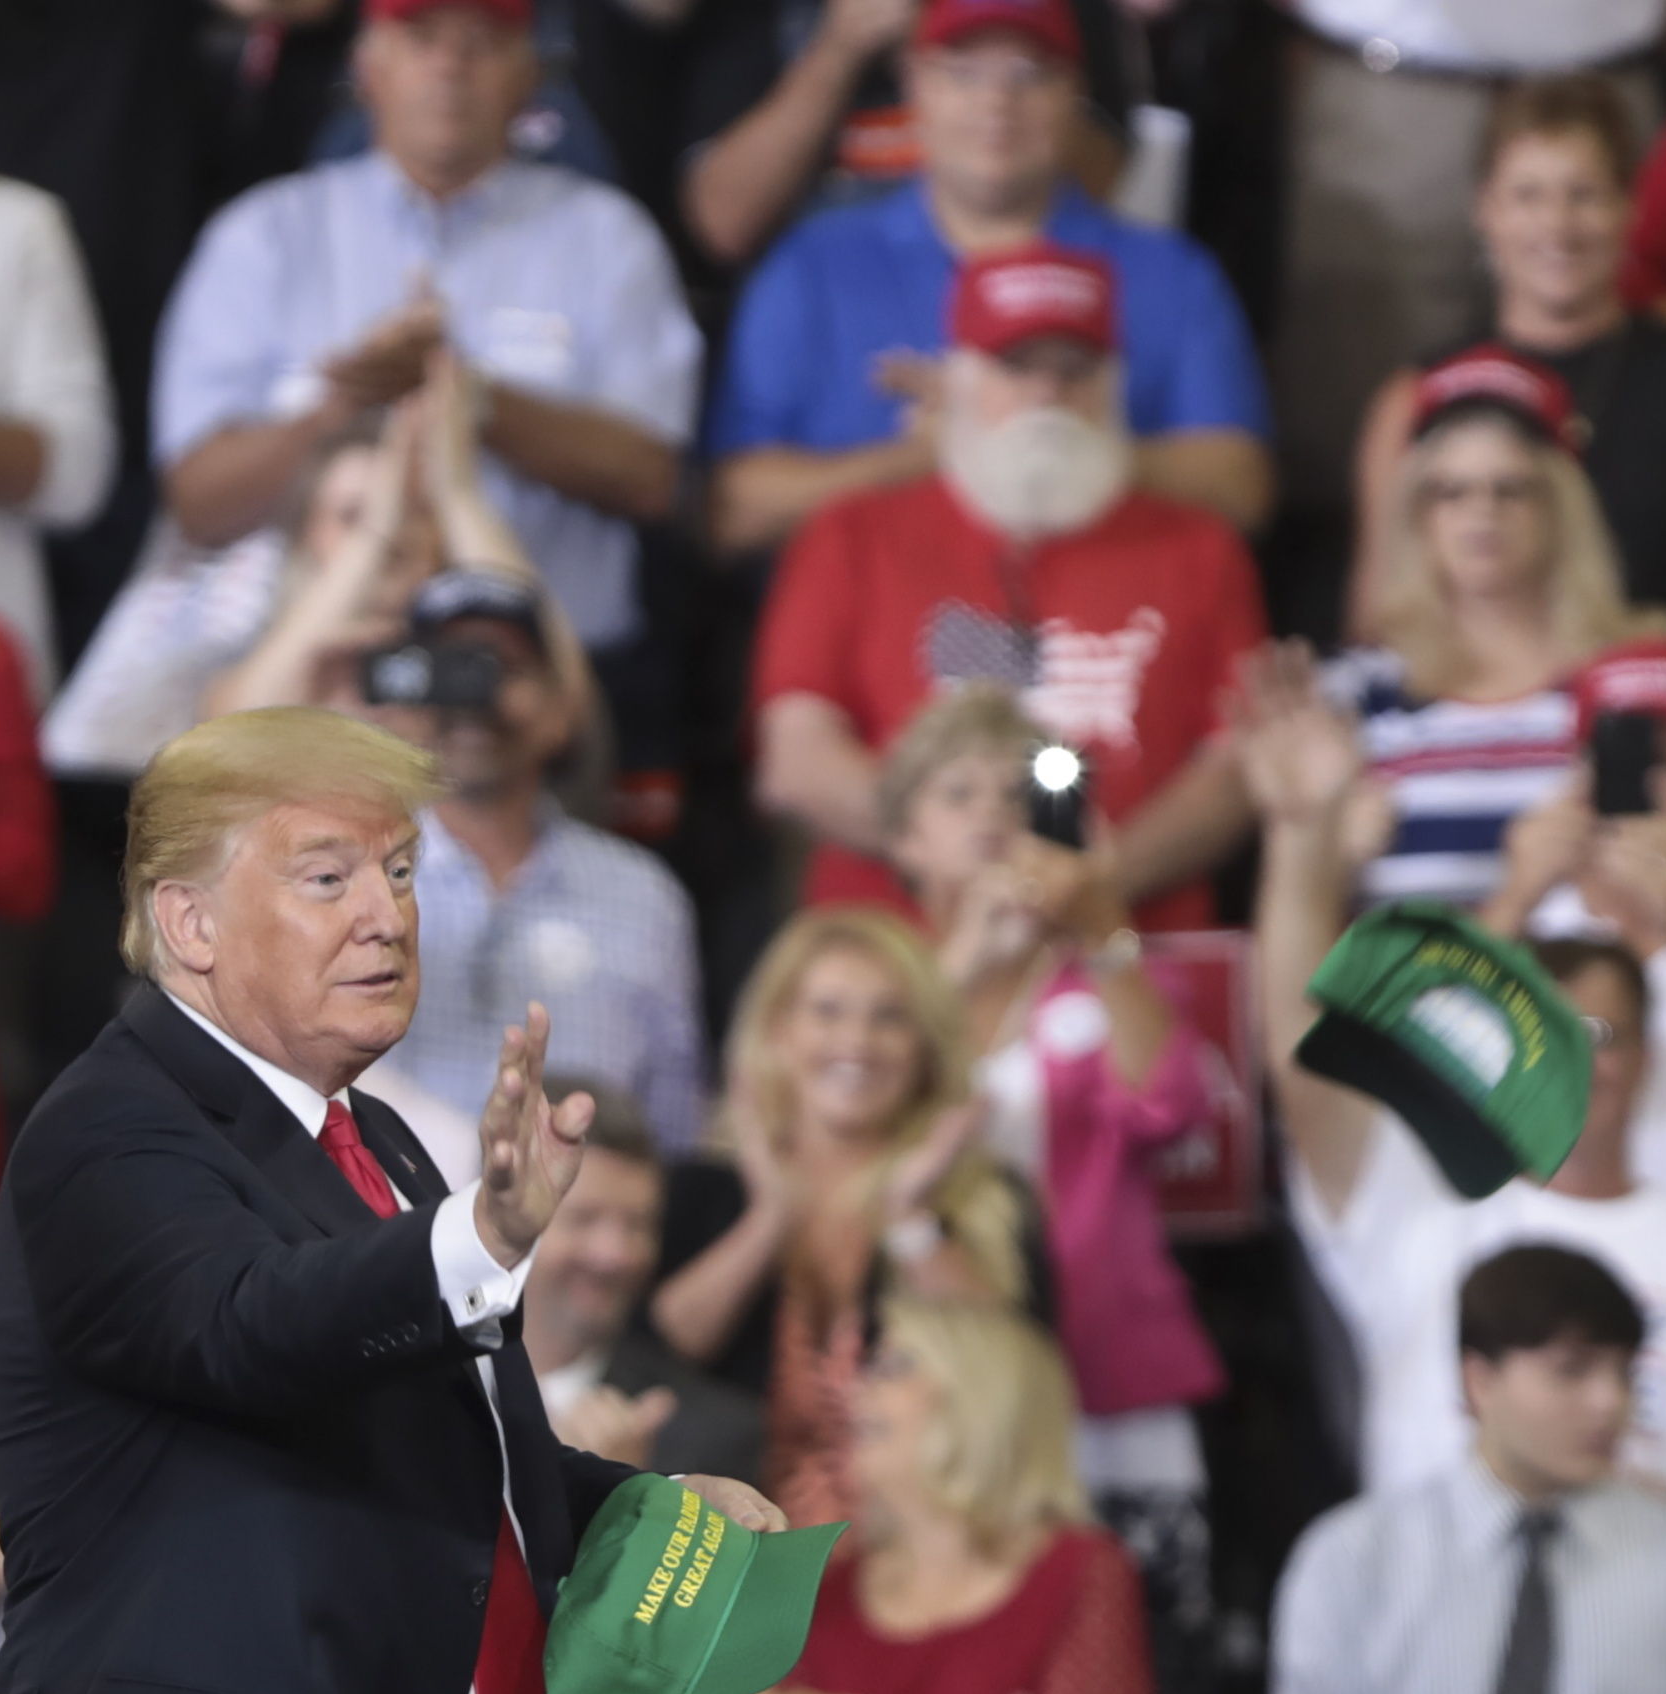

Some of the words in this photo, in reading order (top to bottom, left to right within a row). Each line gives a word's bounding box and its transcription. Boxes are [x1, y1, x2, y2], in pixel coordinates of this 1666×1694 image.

[634, 1566, 674, 1625] MAKE
[662, 1530, 691, 1569] OUR
[673, 1548, 713, 1608] GREAT
